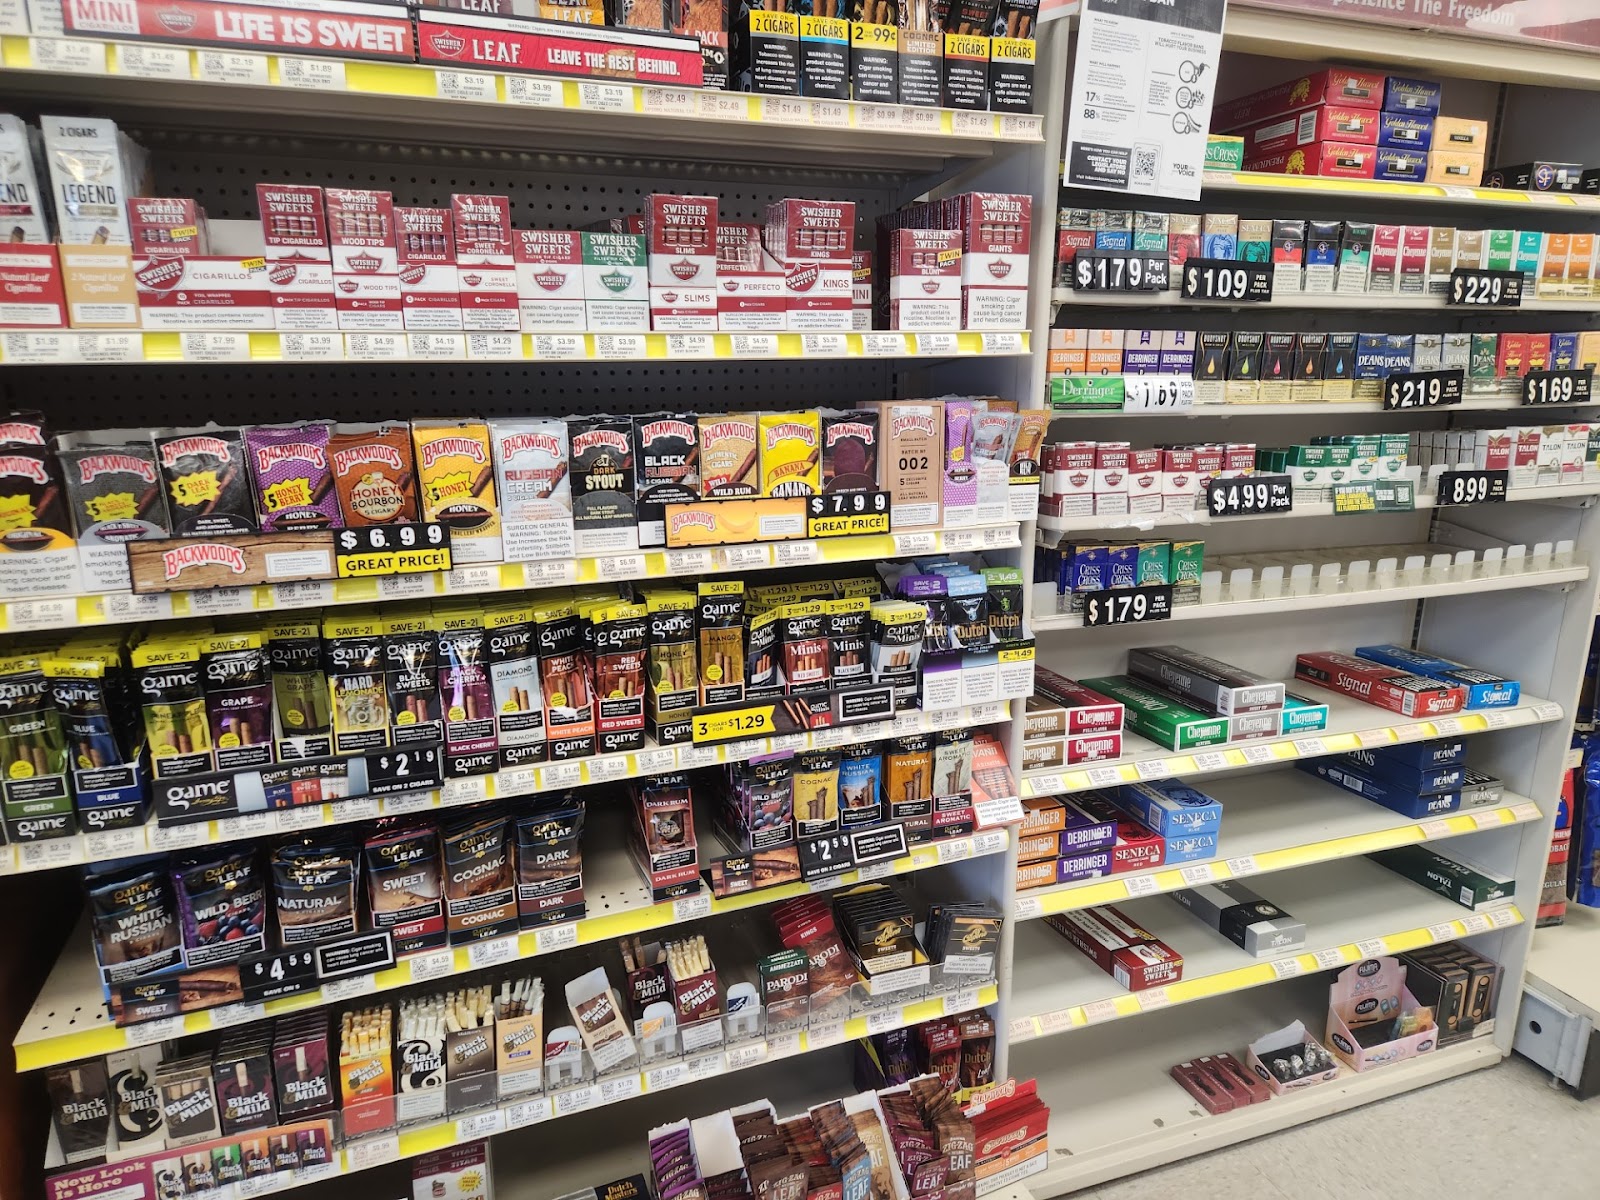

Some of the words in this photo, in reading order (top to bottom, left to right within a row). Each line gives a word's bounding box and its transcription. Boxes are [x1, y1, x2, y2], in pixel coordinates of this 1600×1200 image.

[75, 0, 133, 23] MINI
[1448, 0, 1514, 26] Freedom
[214, 10, 276, 42] LIFE
[280, 16, 313, 44] IS
[319, 22, 406, 52] SWEET
[763, 21, 794, 34] CIGARS
[815, 25, 843, 39] CIGARS
[855, 26, 864, 40] 2
[472, 39, 522, 64] LEAF
[957, 42, 985, 56] CIGARS
[1004, 46, 1032, 58] CIGARS
[547, 48, 581, 66] LEAVE
[584, 52, 605, 69] THE
[608, 53, 635, 72] REST
[638, 59, 681, 76] BEHIND.
[464, 76, 484, 85] $3.19
[532, 83, 552, 92] $3.99
[605, 88, 623, 96] $3.19
[665, 93, 686, 103] $2.49
[718, 102, 739, 111] $2.49
[782, 105, 801, 114] $1.49
[877, 110, 895, 119] $0.99
[69, 126, 98, 138] CIGARS
[1213, 146, 1239, 162] CROSS
[264, 192, 315, 204] SWISHER
[137, 203, 186, 216] SWISHER
[269, 202, 313, 213] SWEETS
[801, 207, 842, 218] SWISHER
[981, 200, 1021, 212] SWISHER
[141, 213, 184, 224] SWEETS
[402, 214, 443, 224] SWISHER
[803, 217, 840, 228] SWEETS
[984, 211, 1020, 222] SWEETS
[406, 223, 443, 232] SWEETS
[285, 237, 323, 247] CIGARILLOS
[341, 237, 362, 247] WOOD
[364, 238, 385, 247] TIPS
[521, 231, 572, 245] SWISHER
[589, 235, 638, 247] SWISHER
[1064, 235, 1091, 248] Signal
[1102, 234, 1127, 248] Signal
[525, 243, 571, 256] SWEETS
[593, 246, 636, 257] SWEETS
[988, 245, 1013, 253] GIANTS
[1373, 245, 1397, 257] Cheyenne
[1402, 247, 1426, 257] Cheyenne
[407, 253, 446, 261] CIGARILLOS
[1148, 259, 1164, 271] Per
[192, 272, 252, 281] CIGARILLOS
[1145, 273, 1167, 284] Pack
[744, 283, 781, 291] PERFECTO
[823, 278, 849, 289] KINGS
[684, 294, 711, 303] SLIMS
[213, 336, 235, 345] $7.99
[310, 336, 331, 345] $3.99
[435, 337, 455, 345] $4.19
[557, 338, 576, 346] $3.99
[618, 338, 636, 346] $3.99
[1128, 354, 1158, 364] DERRINGER
[1163, 354, 1193, 363] DERRINGER
[1358, 356, 1384, 366] DEANS
[1384, 357, 1410, 368] DEANS
[1062, 379, 1115, 396] Derringer
[641, 420, 696, 448] BACKWOODS
[765, 425, 816, 451] BACKWOODS
[161, 436, 230, 468] BACKWOODS
[421, 437, 486, 468] BACKWOODS
[502, 434, 562, 461] BACKWOODS
[1518, 444, 1539, 452] TALON
[1542, 443, 1561, 451] TALON
[258, 444, 326, 473] BACKWOODS
[334, 445, 403, 477] BACKWOODS
[644, 455, 686, 467] BLACK
[898, 457, 929, 471] 002
[772, 462, 806, 477] BANANA
[439, 480, 468, 497] HONEY
[507, 481, 552, 494] CREAM
[585, 474, 624, 490] STOUT
[351, 485, 398, 497] HONEY
[351, 497, 404, 510] BOURBON
[1270, 495, 1290, 507] Pack
[814, 519, 850, 532] GREAT
[852, 514, 885, 529] PRICE!
[164, 545, 247, 580] BACKWOODS
[346, 555, 393, 572] GREAT
[399, 554, 445, 568] PRICE!
[619, 558, 637, 566] $6.99
[1079, 564, 1101, 575] CRISS
[404, 575, 423, 583] $6.99
[1077, 574, 1101, 585] CROSS
[988, 613, 1021, 631] Dutch
[789, 642, 821, 656] Minis
[832, 638, 864, 653] Minis
[398, 673, 426, 682] BLACK
[496, 665, 533, 678] DIAMOND
[140, 673, 199, 697] game
[343, 675, 373, 689] HARD
[395, 679, 431, 689] SWEETS
[1335, 672, 1373, 696] Signal
[221, 696, 254, 707] GRAPE
[1481, 688, 1512, 702] Signal
[1077, 709, 1116, 724] Cheyenne
[9, 720, 46, 734] GREEN
[699, 723, 707, 735] 3
[729, 714, 764, 730] $1.29
[1187, 723, 1222, 738] Cheyenne
[555, 738, 591, 758] game
[408, 780, 434, 790] CIGARS
[166, 780, 230, 810] game
[646, 799, 670, 808] DARK
[1428, 800, 1451, 811] DEANS
[87, 806, 135, 830] game
[935, 813, 971, 823] AROMATIC
[536, 849, 570, 864] DARK
[1115, 846, 1161, 861] SENECA
[453, 855, 506, 883] COGNAC
[1063, 854, 1108, 874] DERRINGER
[382, 872, 427, 891] SWEET
[277, 896, 342, 909] NATURAL
[194, 902, 229, 922] WILD
[461, 909, 505, 926] COGNAC
[109, 914, 173, 944] RUSSIAN
[800, 926, 818, 939] KINGS
[1143, 961, 1174, 975] SWISHER
[766, 972, 808, 992] PARODI
[405, 1050, 442, 1064] Black
[964, 1052, 991, 1066] Dutch
[411, 1059, 443, 1074] Mild
[286, 1076, 326, 1094] Black
[294, 1086, 328, 1102] Mild
[104, 1160, 146, 1177] Look
[76, 1176, 123, 1193] Here
[915, 1174, 944, 1192] LEAF
